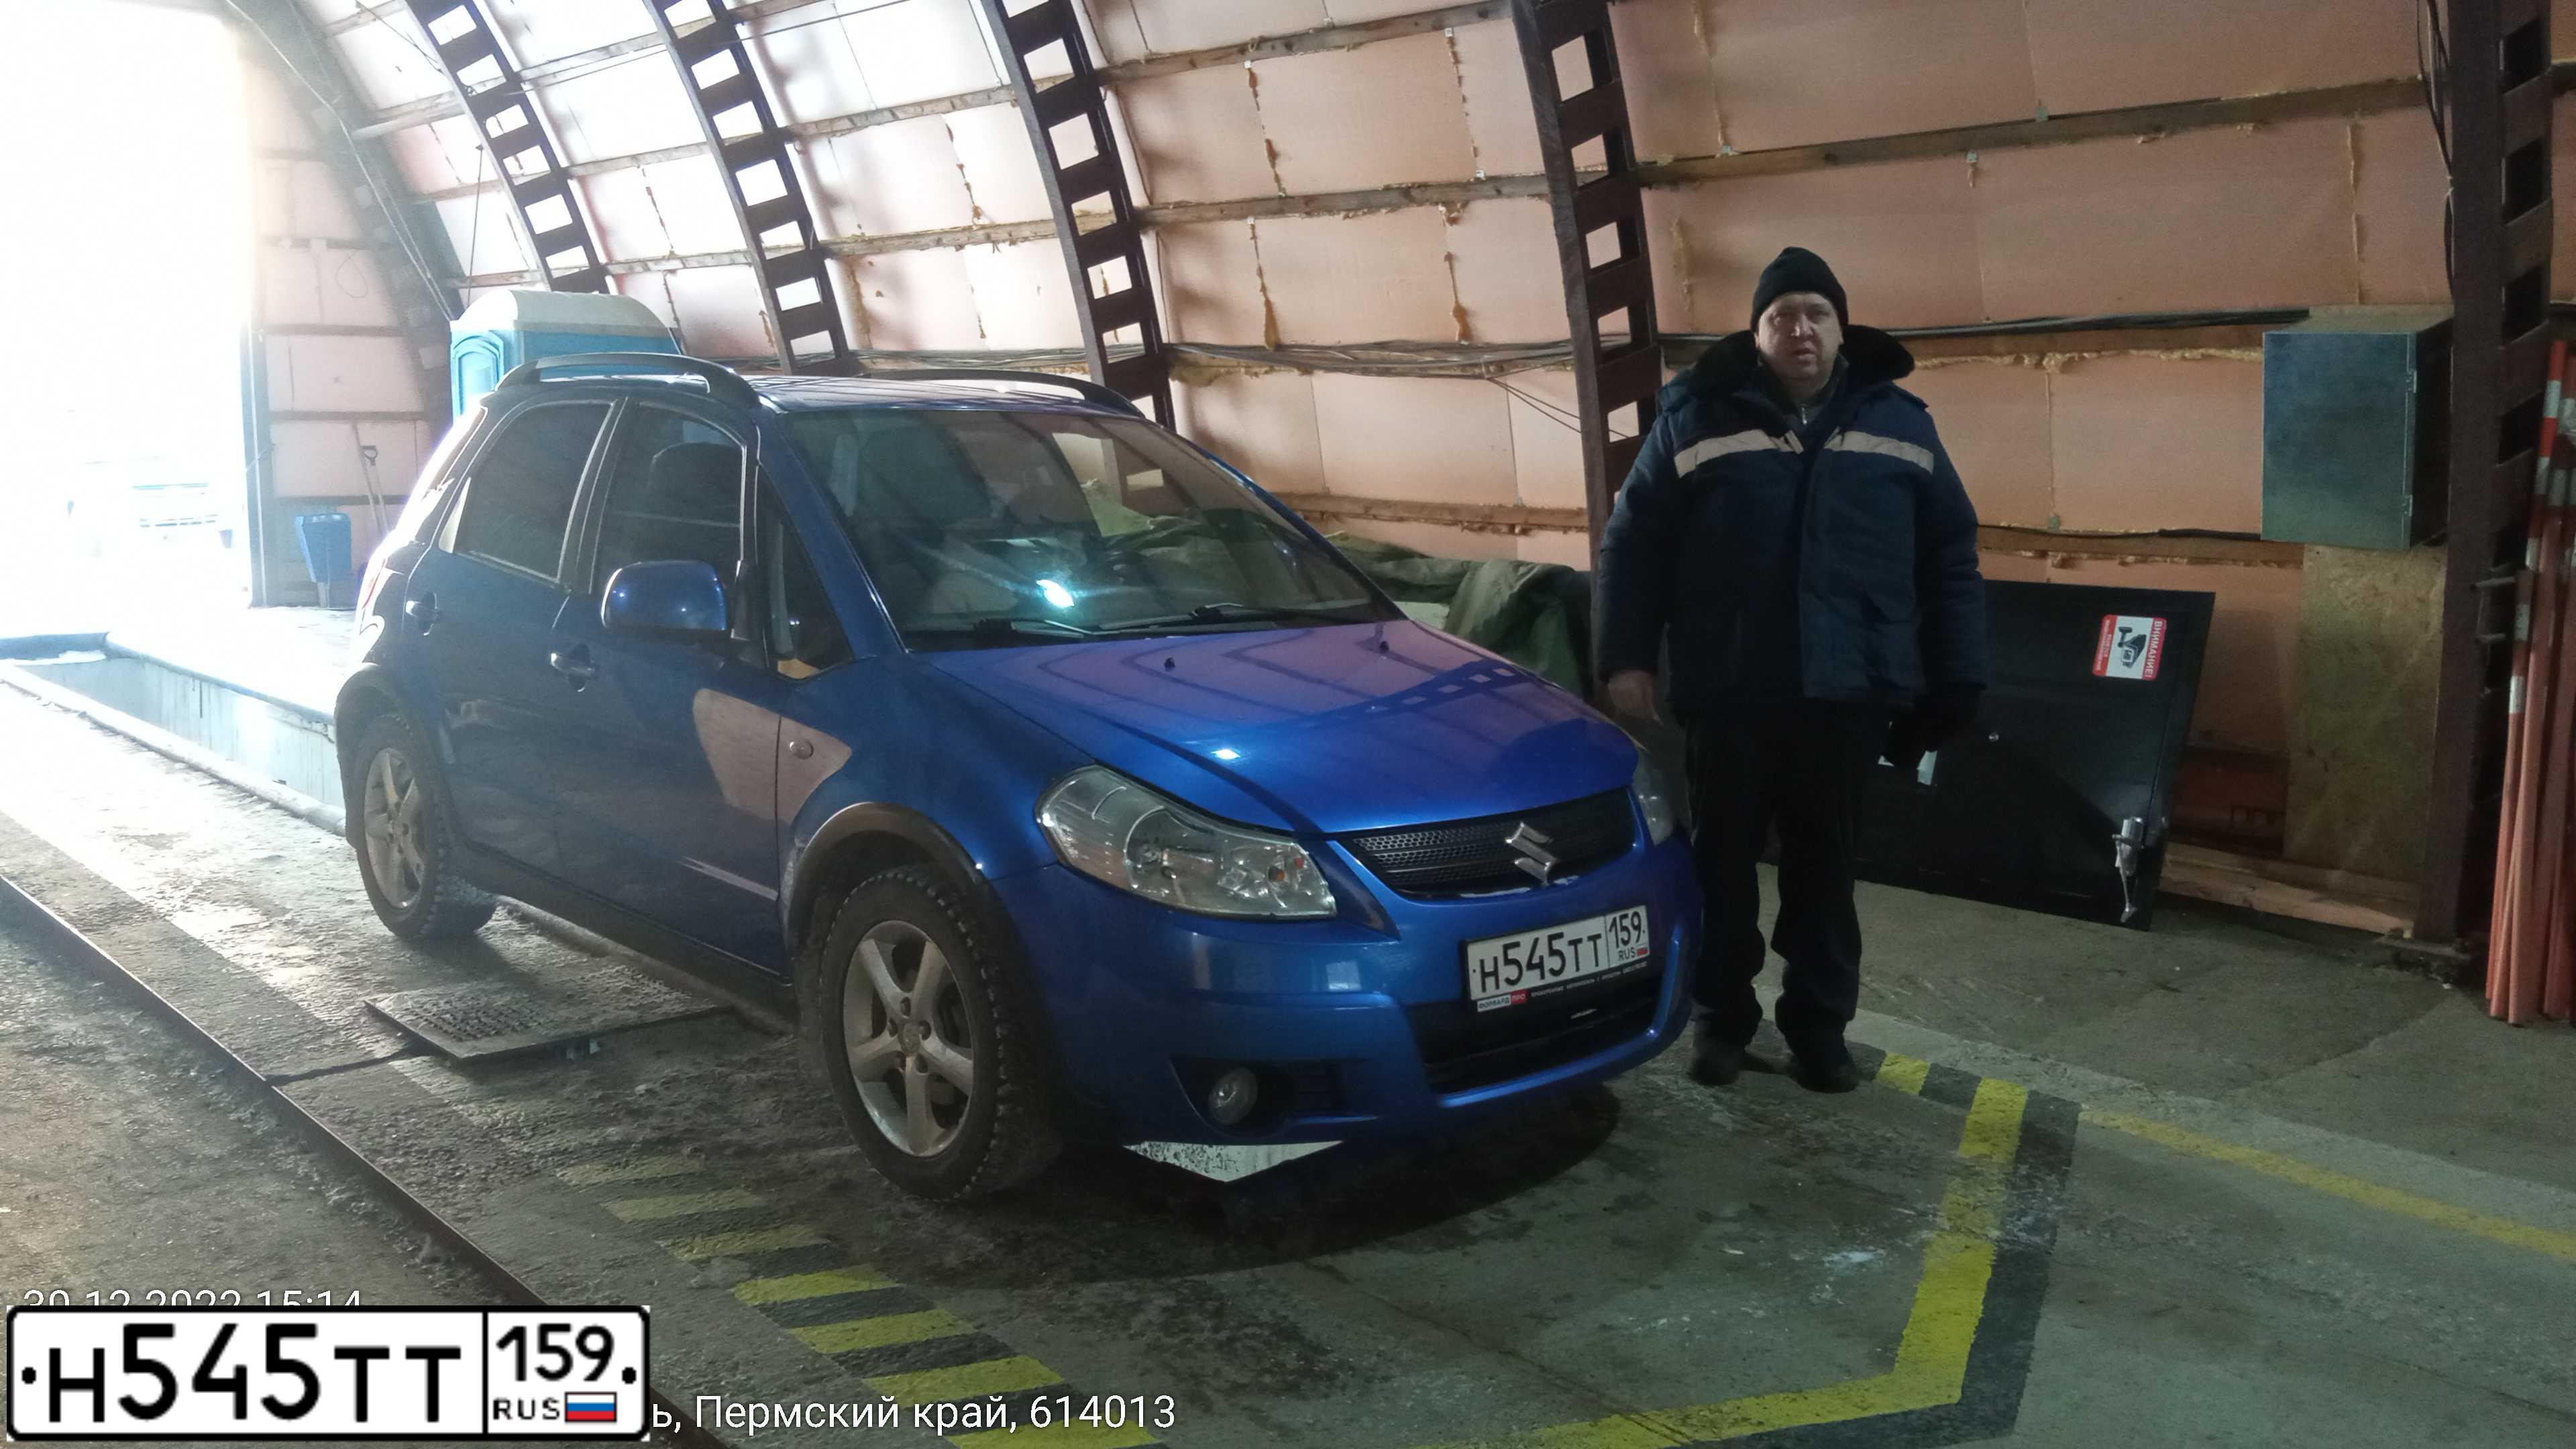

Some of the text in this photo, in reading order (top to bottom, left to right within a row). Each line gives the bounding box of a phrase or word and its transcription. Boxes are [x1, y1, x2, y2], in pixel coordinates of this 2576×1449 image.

[2145, 621, 2162, 678] ВНИМАНИЕ!
[1479, 932, 1602, 993] Н545ТТ
[1609, 911, 1642, 949] 159
[1618, 949, 1636, 961] RUS
